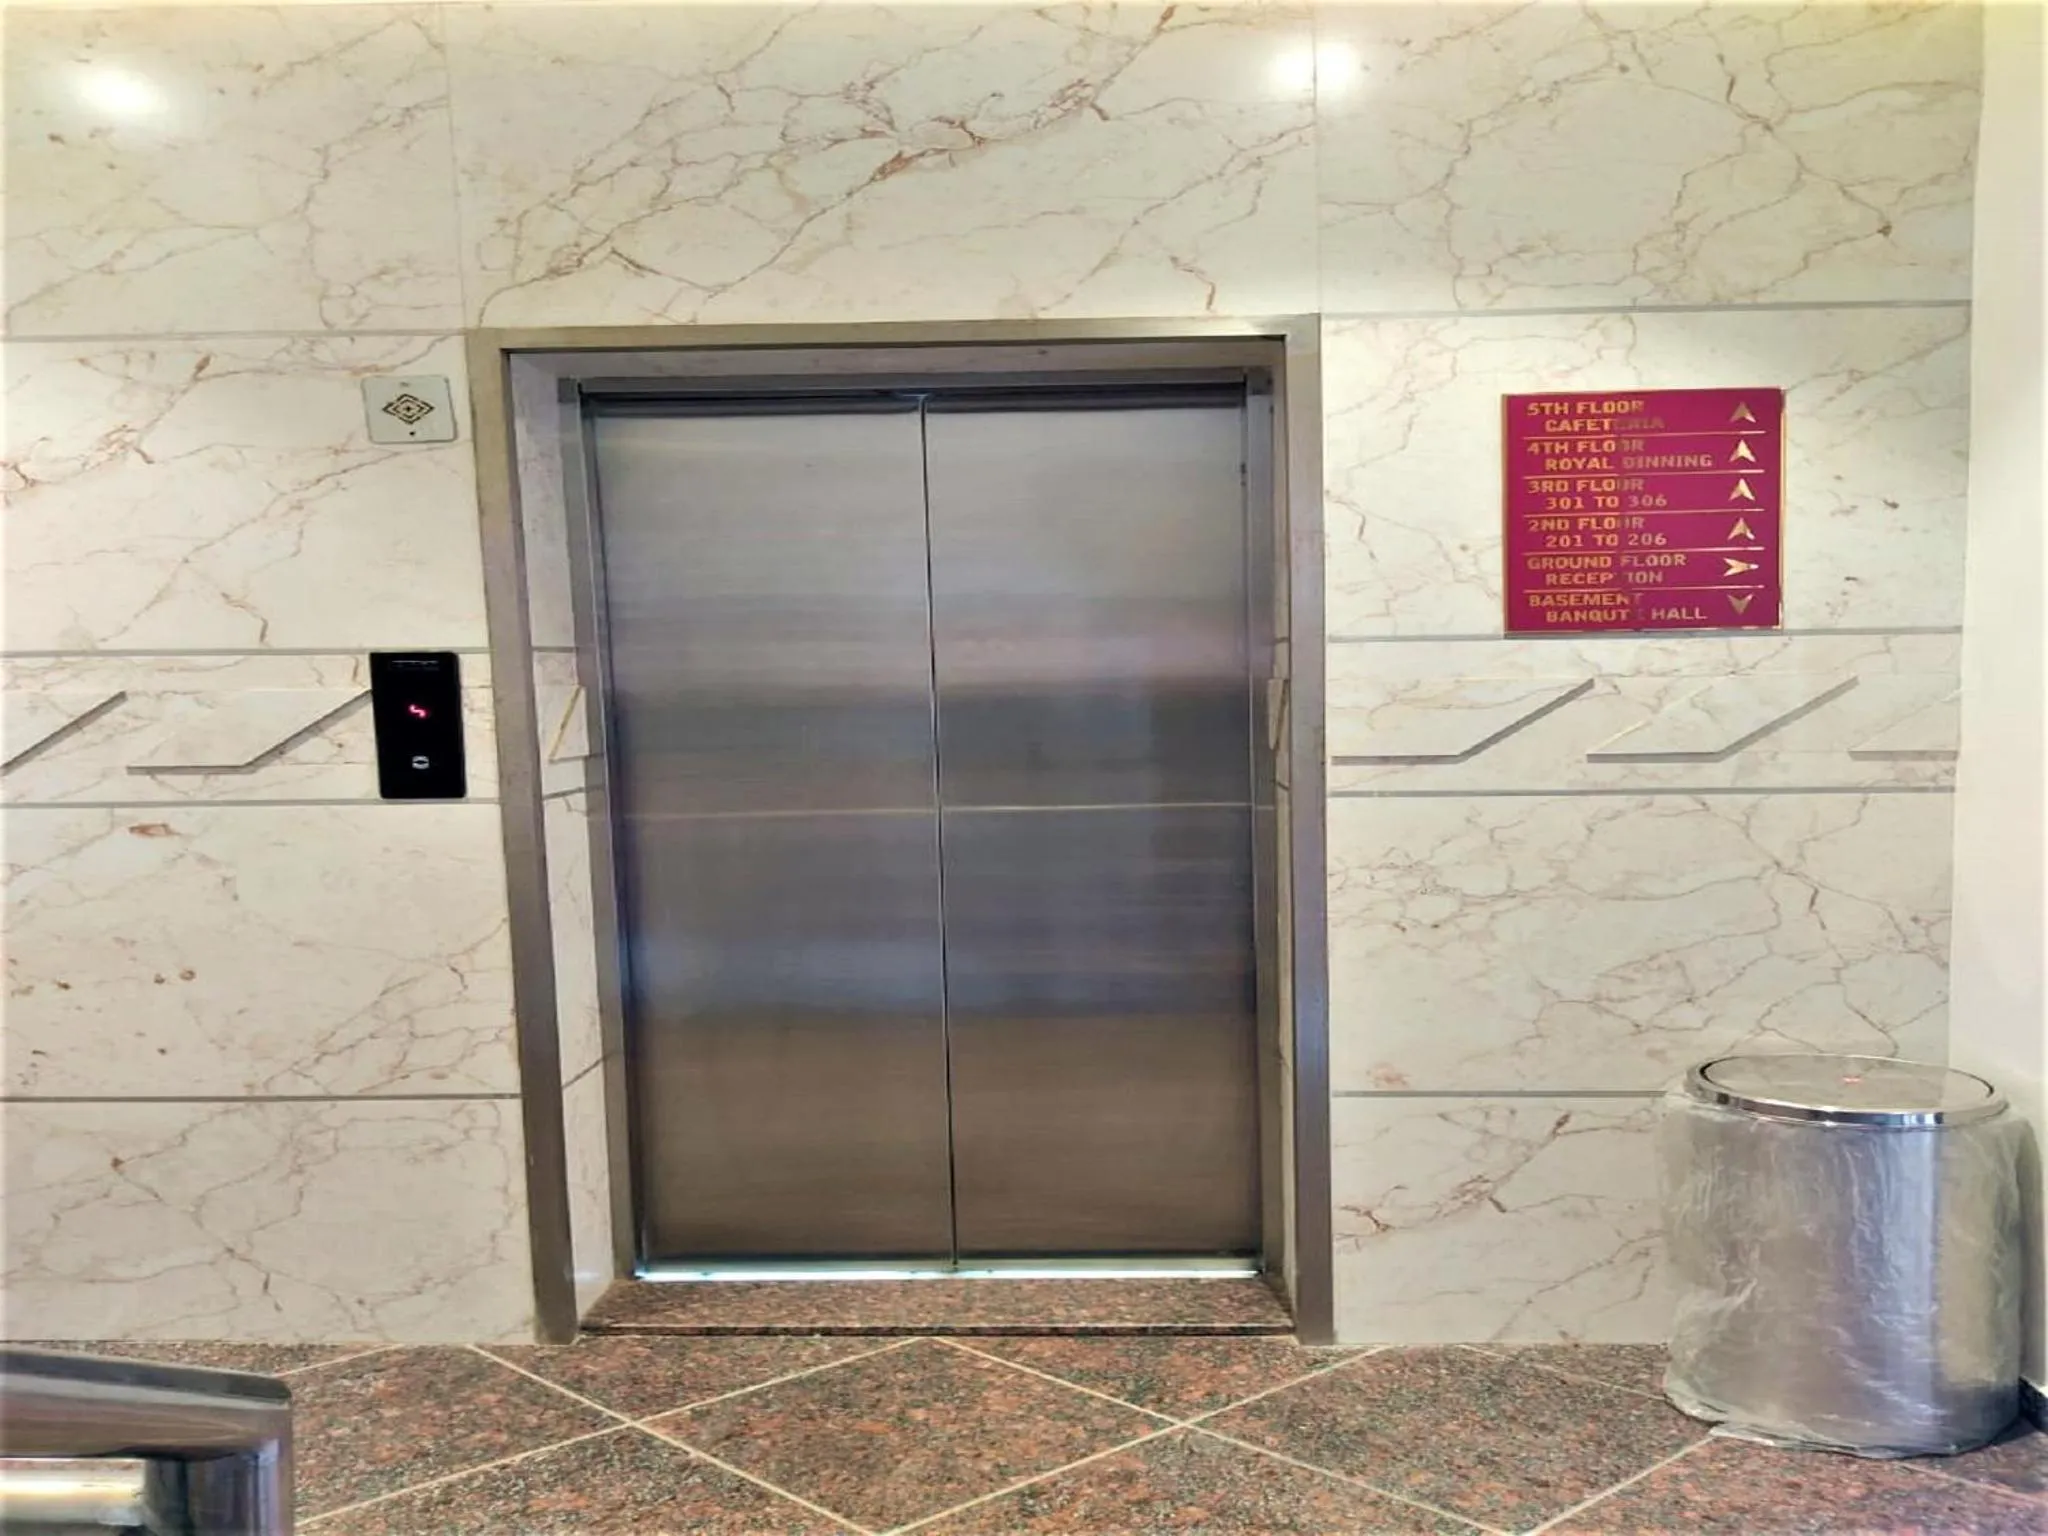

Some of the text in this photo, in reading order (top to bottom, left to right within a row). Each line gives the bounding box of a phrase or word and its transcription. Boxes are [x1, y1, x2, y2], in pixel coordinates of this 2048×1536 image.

[1526, 400, 1644, 415] 5TH FLOOR
[1545, 416, 1665, 432] CAFETRIA
[1526, 441, 1569, 455] 4TH
[1545, 454, 1713, 471] ROYAL DINNING
[1527, 480, 1569, 493] 3RD
[1545, 493, 1668, 510] 301 TO 306
[1528, 518, 1570, 531] 2ND
[1545, 532, 1668, 548] 201 TO 206
[1527, 553, 1687, 570] GROUND FLOOR
[1545, 571, 1663, 586] RECEPION
[1651, 606, 1707, 620] HALL
